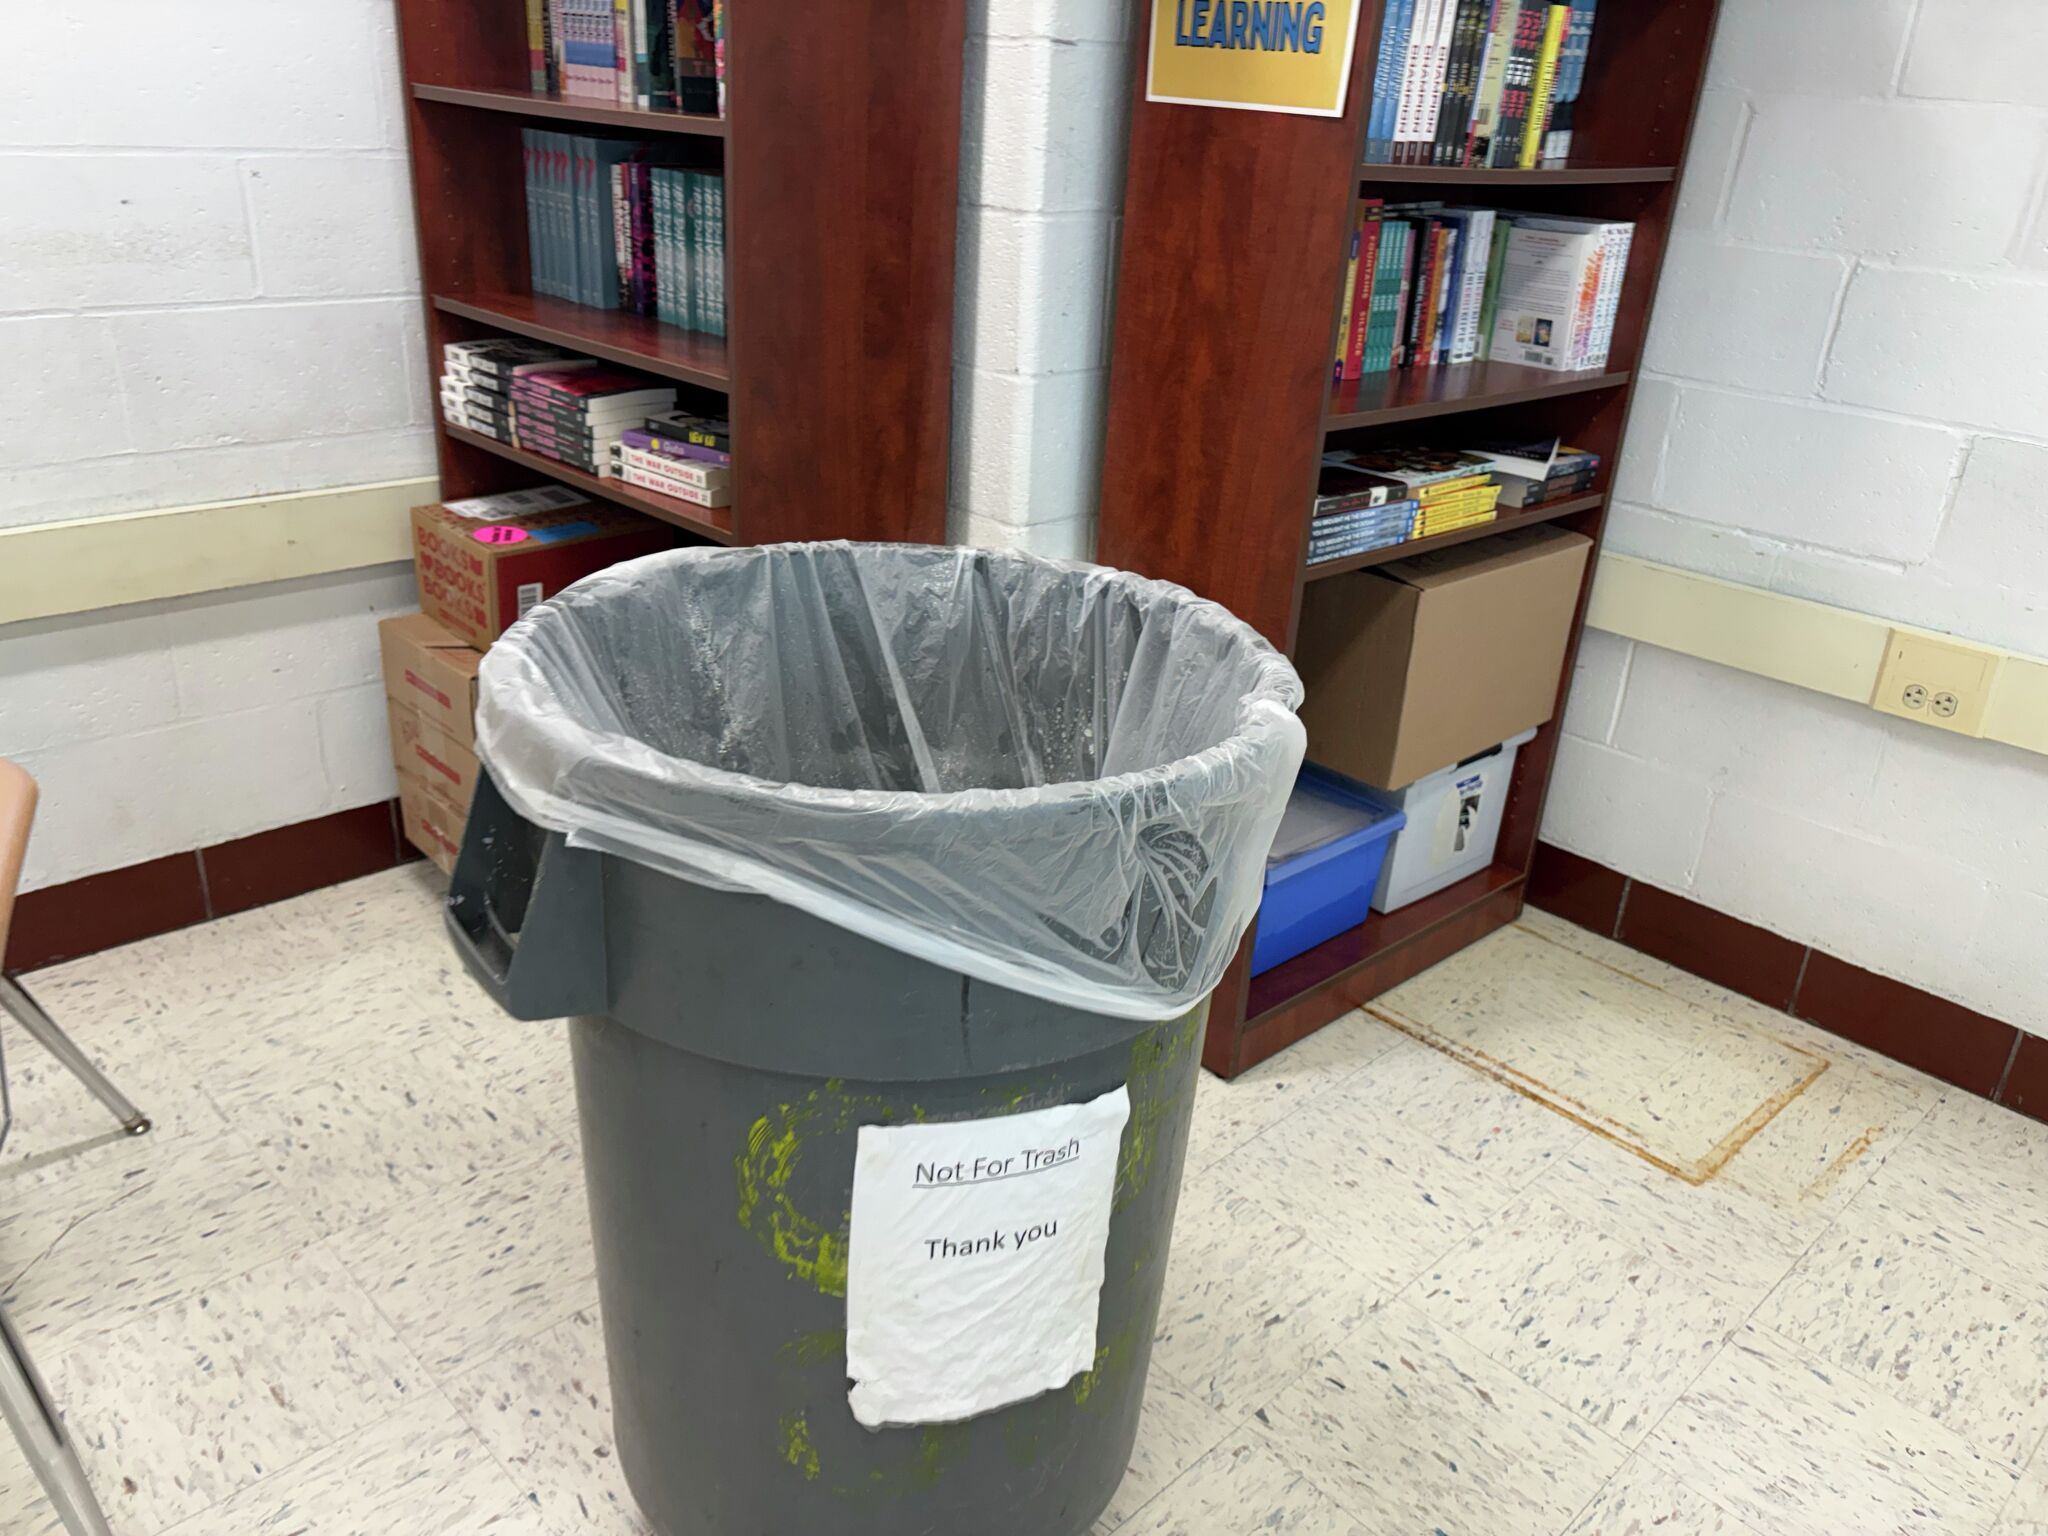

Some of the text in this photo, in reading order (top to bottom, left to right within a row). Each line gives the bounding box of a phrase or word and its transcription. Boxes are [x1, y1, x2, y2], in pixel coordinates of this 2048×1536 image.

[1175, 0, 1325, 54] LEARNING
[1353, 235, 1376, 357] FOUNTAINS SILENCE
[631, 454, 694, 480] THE WAR OUTSIDE
[633, 473, 699, 499] THE WAR OUTSIDE
[417, 526, 468, 571] BOOKS
[423, 575, 473, 620] BOOKS
[434, 559, 485, 604] BOOKS
[915, 1137, 1080, 1184] Not For Trash
[924, 1220, 1057, 1260] Thank you
